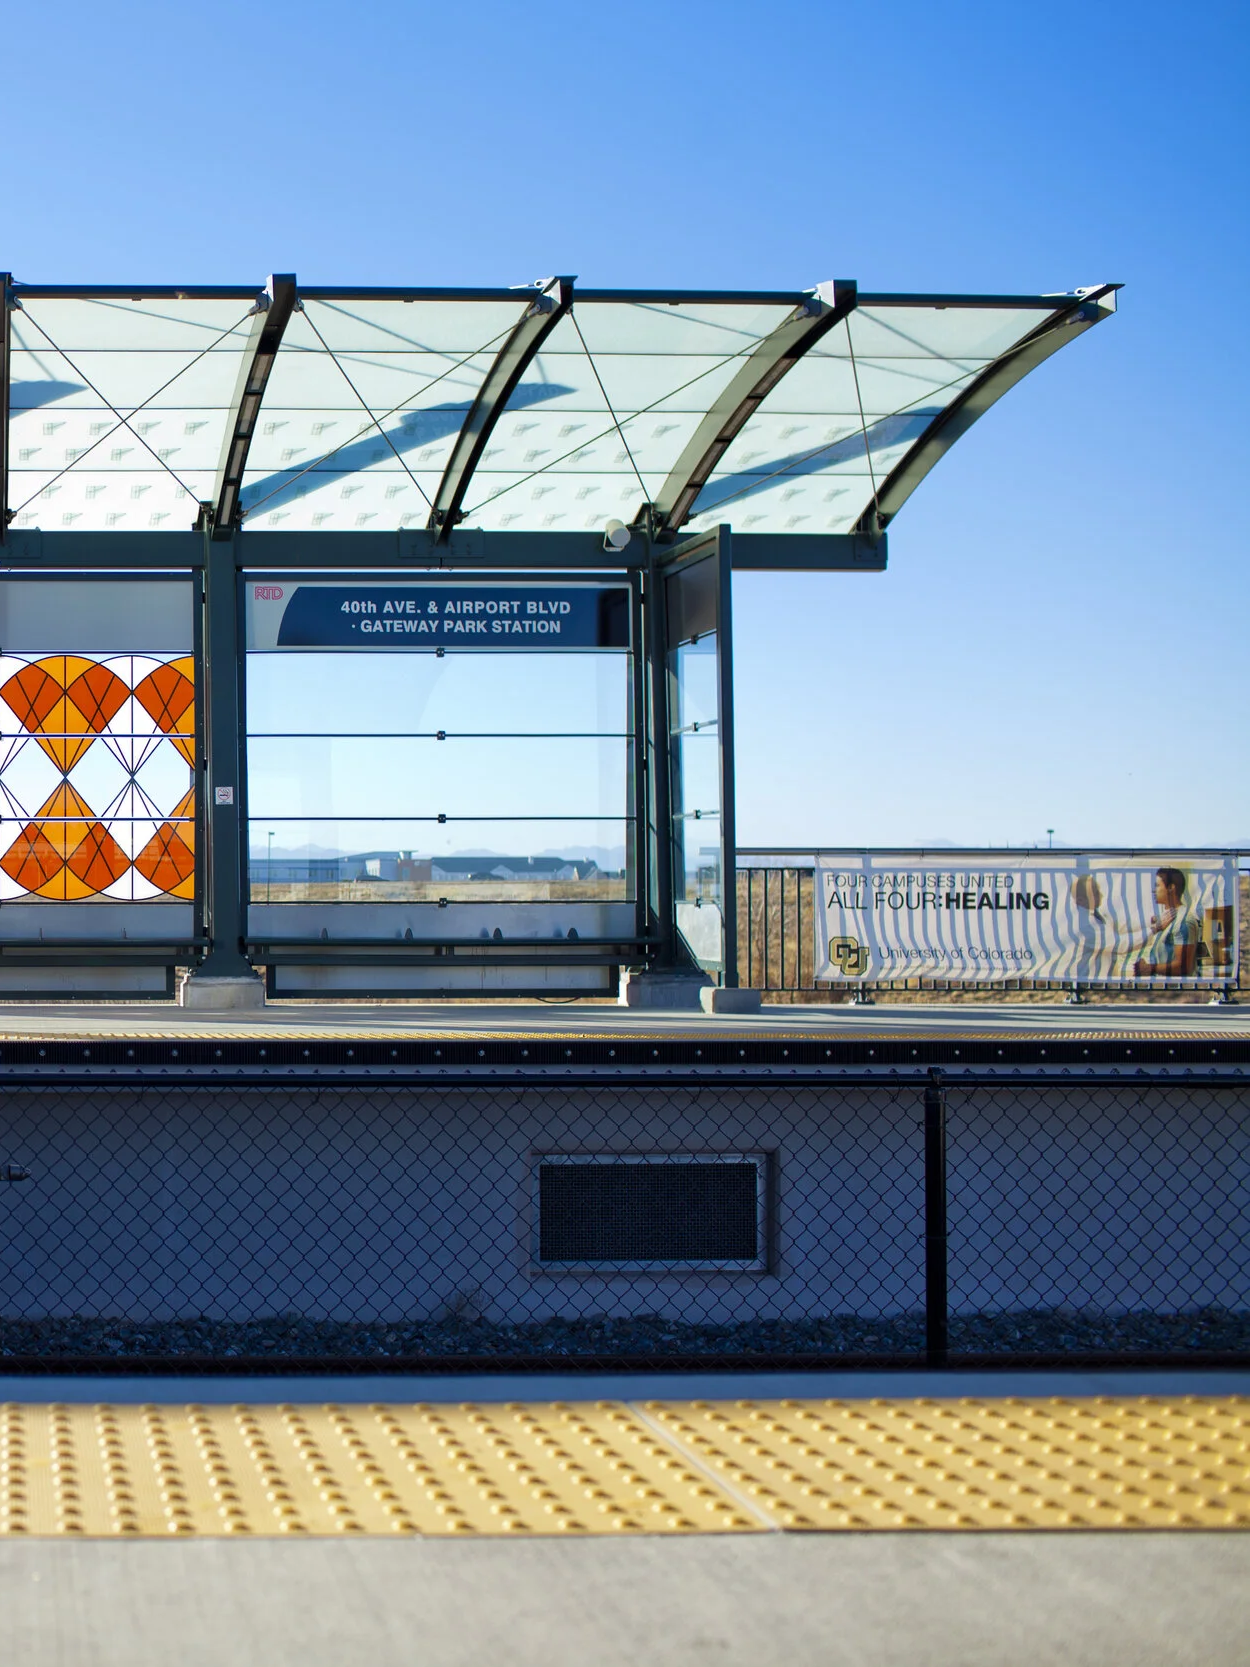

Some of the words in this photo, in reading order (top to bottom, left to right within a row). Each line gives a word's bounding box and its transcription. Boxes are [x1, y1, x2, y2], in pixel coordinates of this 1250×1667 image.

[254, 586, 283, 600] RTD
[340, 601, 377, 614] 40th
[383, 601, 421, 614] AVE.
[427, 601, 439, 614] &
[444, 601, 520, 614] AIRPORT
[527, 601, 571, 614] BLVD
[360, 620, 440, 633] GATEWAY
[444, 620, 488, 633] PARK
[492, 620, 561, 633] STATION
[827, 875, 868, 887] FOUR
[872, 875, 955, 888] CAMPUSES
[960, 875, 1014, 888] UNITED
[827, 891, 868, 909] ALL
[829, 936, 869, 975] CU
[878, 946, 946, 961] University
[951, 946, 965, 959] of
[968, 946, 1033, 960] Colorado
